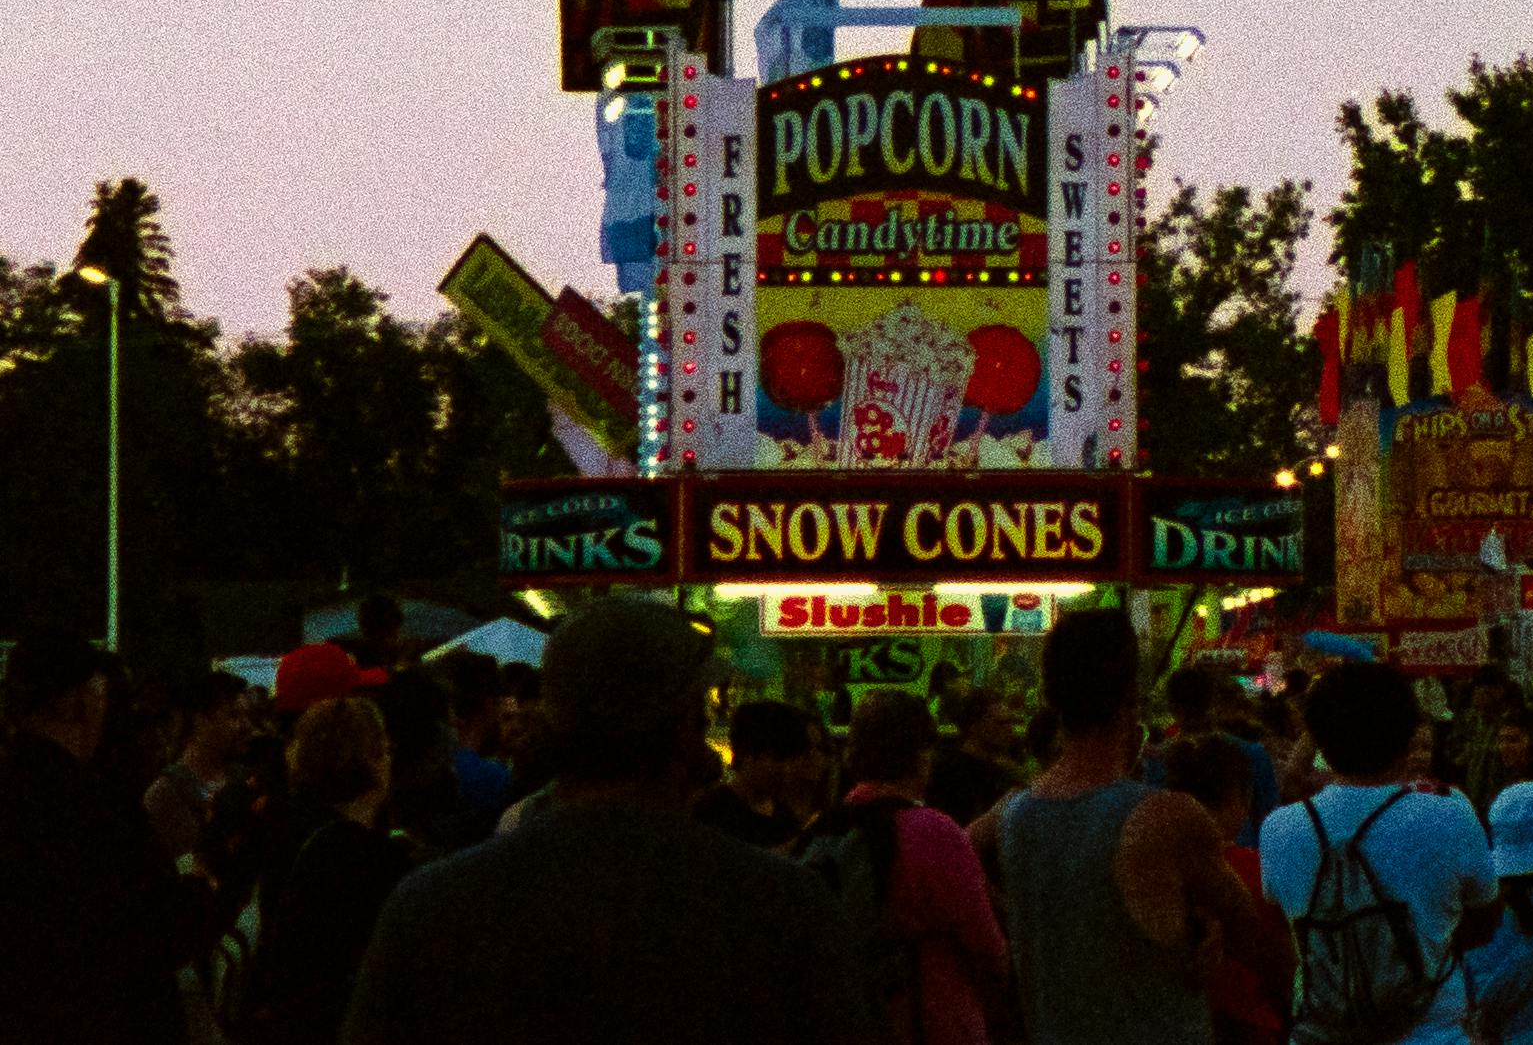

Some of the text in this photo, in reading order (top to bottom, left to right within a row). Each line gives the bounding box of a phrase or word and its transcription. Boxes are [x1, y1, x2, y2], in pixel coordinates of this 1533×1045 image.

[772, 89, 1031, 196] POPCORN
[720, 135, 744, 415] FRESH
[785, 208, 1020, 259] Candytime
[1062, 133, 1088, 412] SWEETS
[708, 502, 1104, 562] SNOW CONES
[778, 594, 970, 628] Slushie
